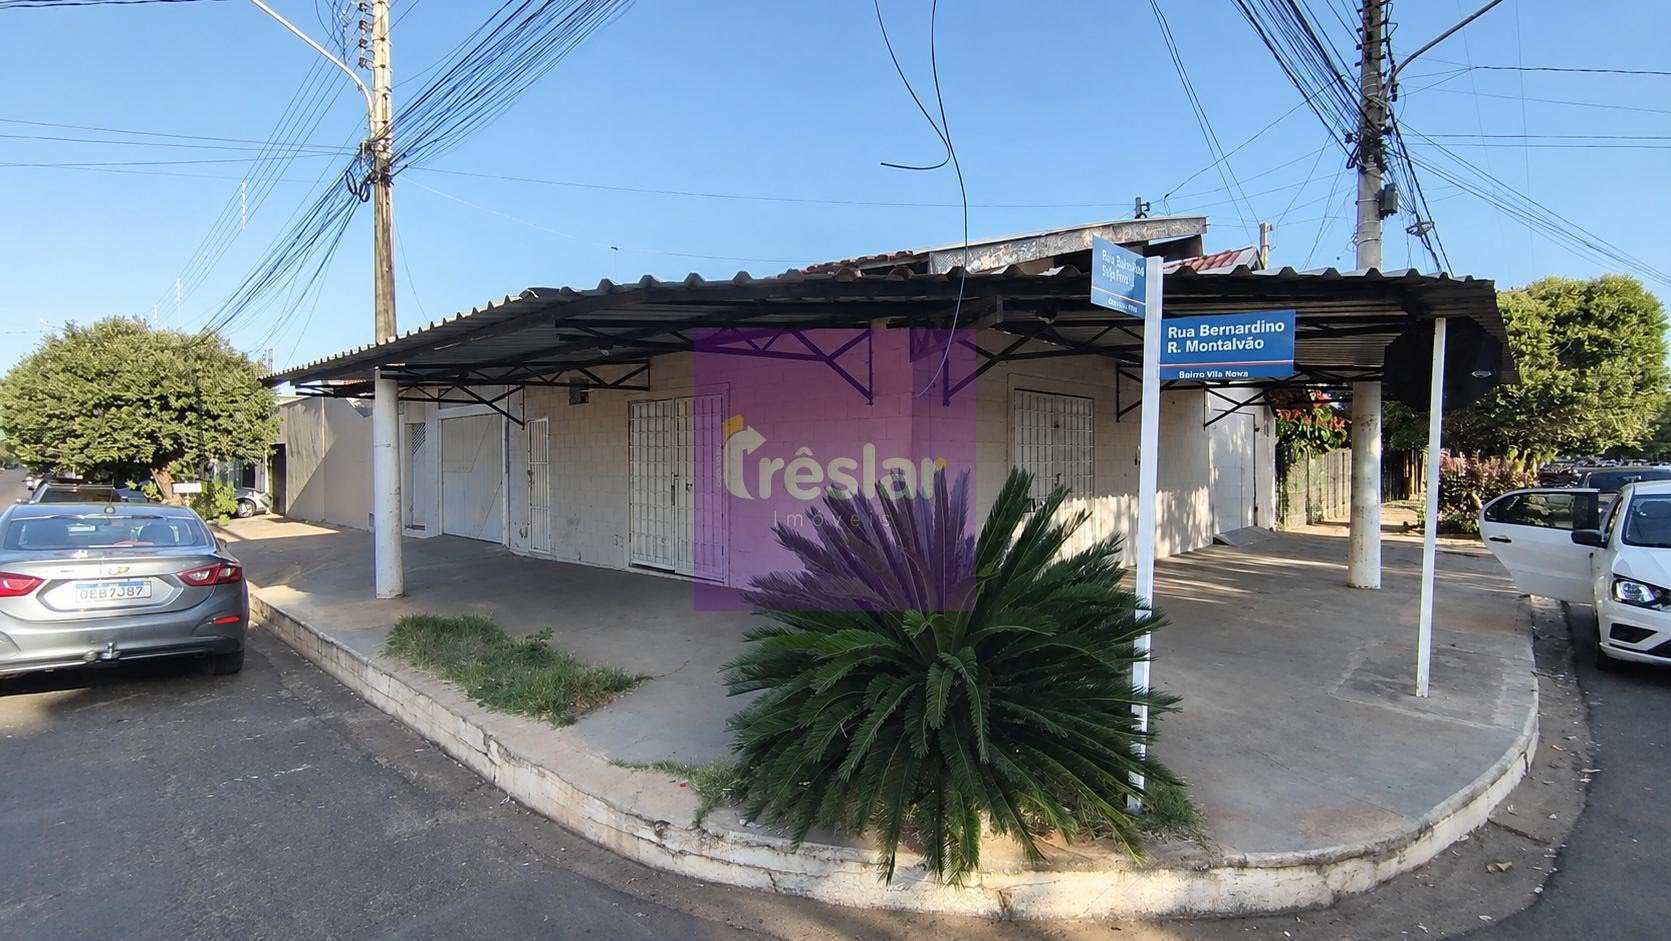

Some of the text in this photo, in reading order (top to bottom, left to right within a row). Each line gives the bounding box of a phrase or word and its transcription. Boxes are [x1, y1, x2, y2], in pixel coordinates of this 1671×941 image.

[1168, 320, 1285, 339] Rua Bernardino
[1167, 336, 1264, 354] R. Montalvão
[1206, 370, 1223, 378] Vila
